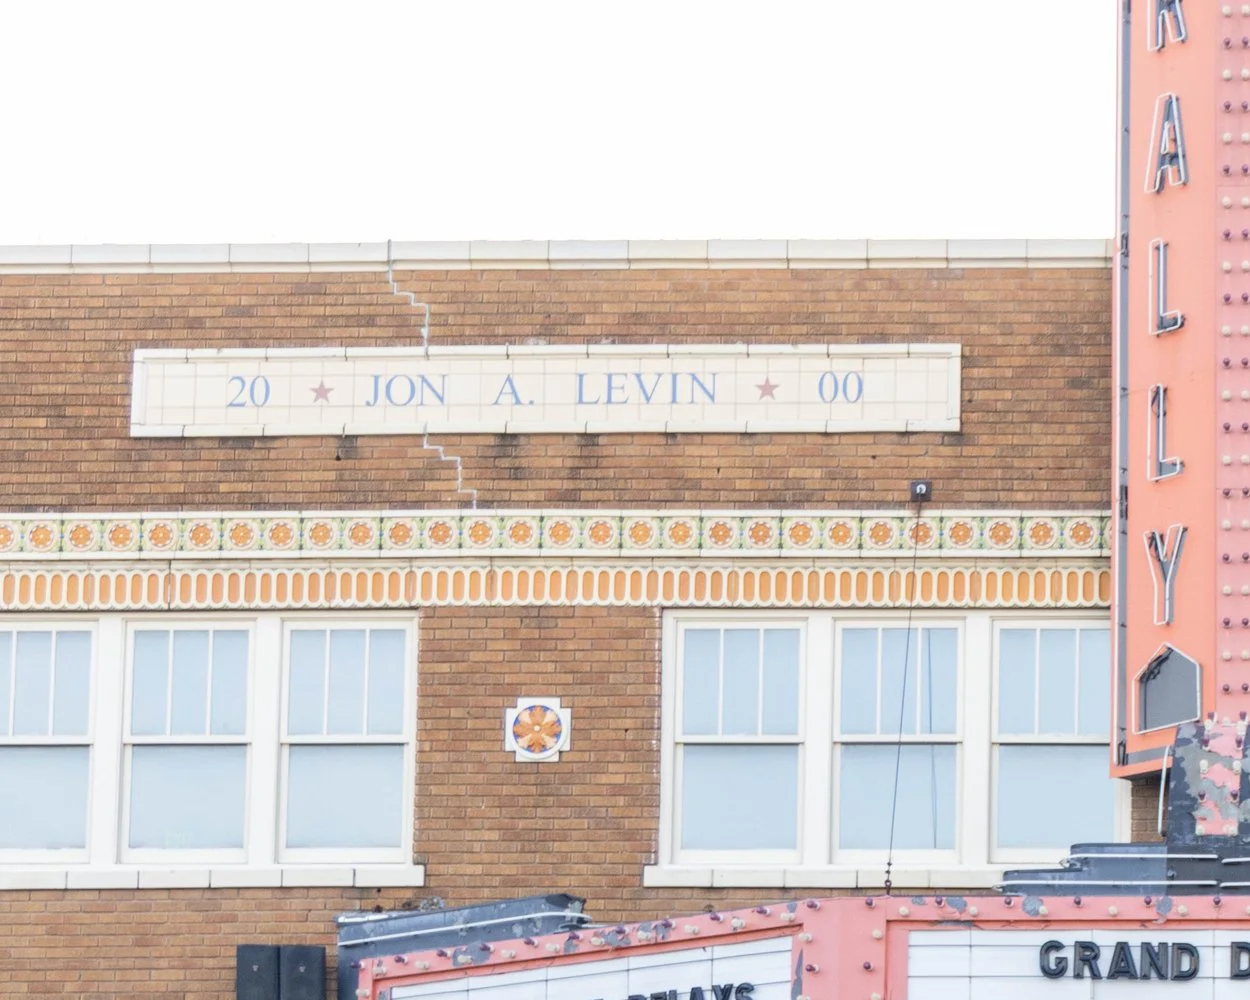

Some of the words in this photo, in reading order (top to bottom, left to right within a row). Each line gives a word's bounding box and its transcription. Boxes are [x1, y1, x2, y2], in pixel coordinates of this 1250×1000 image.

[226, 376, 271, 409] 20
[365, 374, 449, 408] JON
[492, 374, 536, 407] A.
[575, 372, 719, 407] LEVIN
[817, 371, 864, 405] 00
[1039, 940, 1201, 981] GRAND
